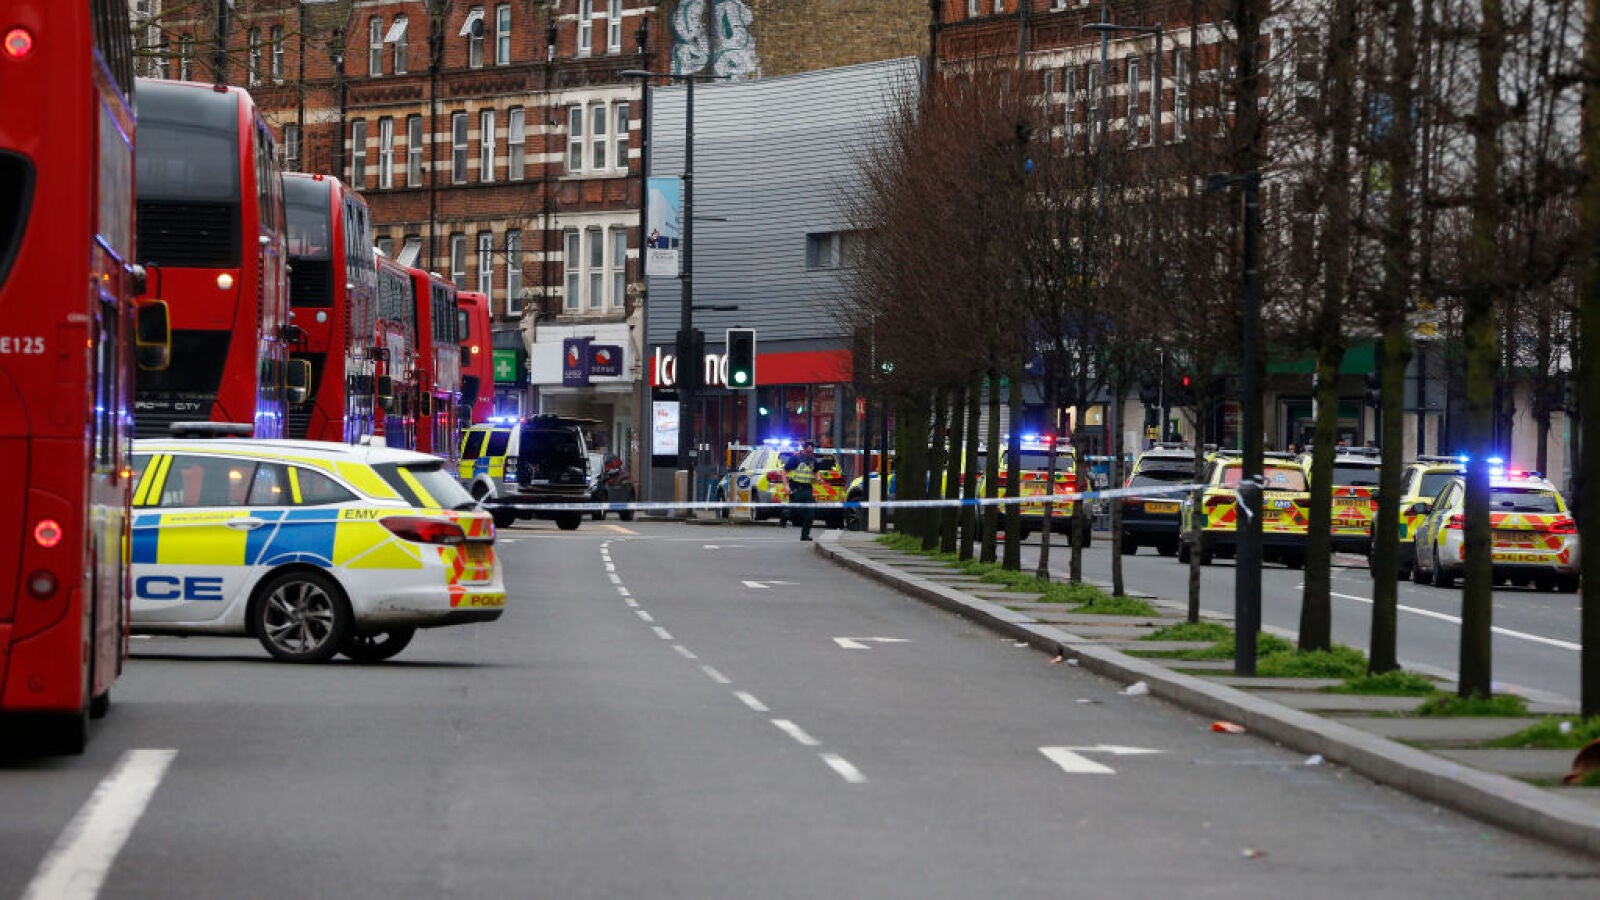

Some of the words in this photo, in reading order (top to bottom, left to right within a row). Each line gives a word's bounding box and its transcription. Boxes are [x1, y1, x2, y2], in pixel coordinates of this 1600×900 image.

[344, 509, 378, 519] EMV
[1329, 519, 1372, 528] OLIC
[1491, 554, 1551, 562] OLICE
